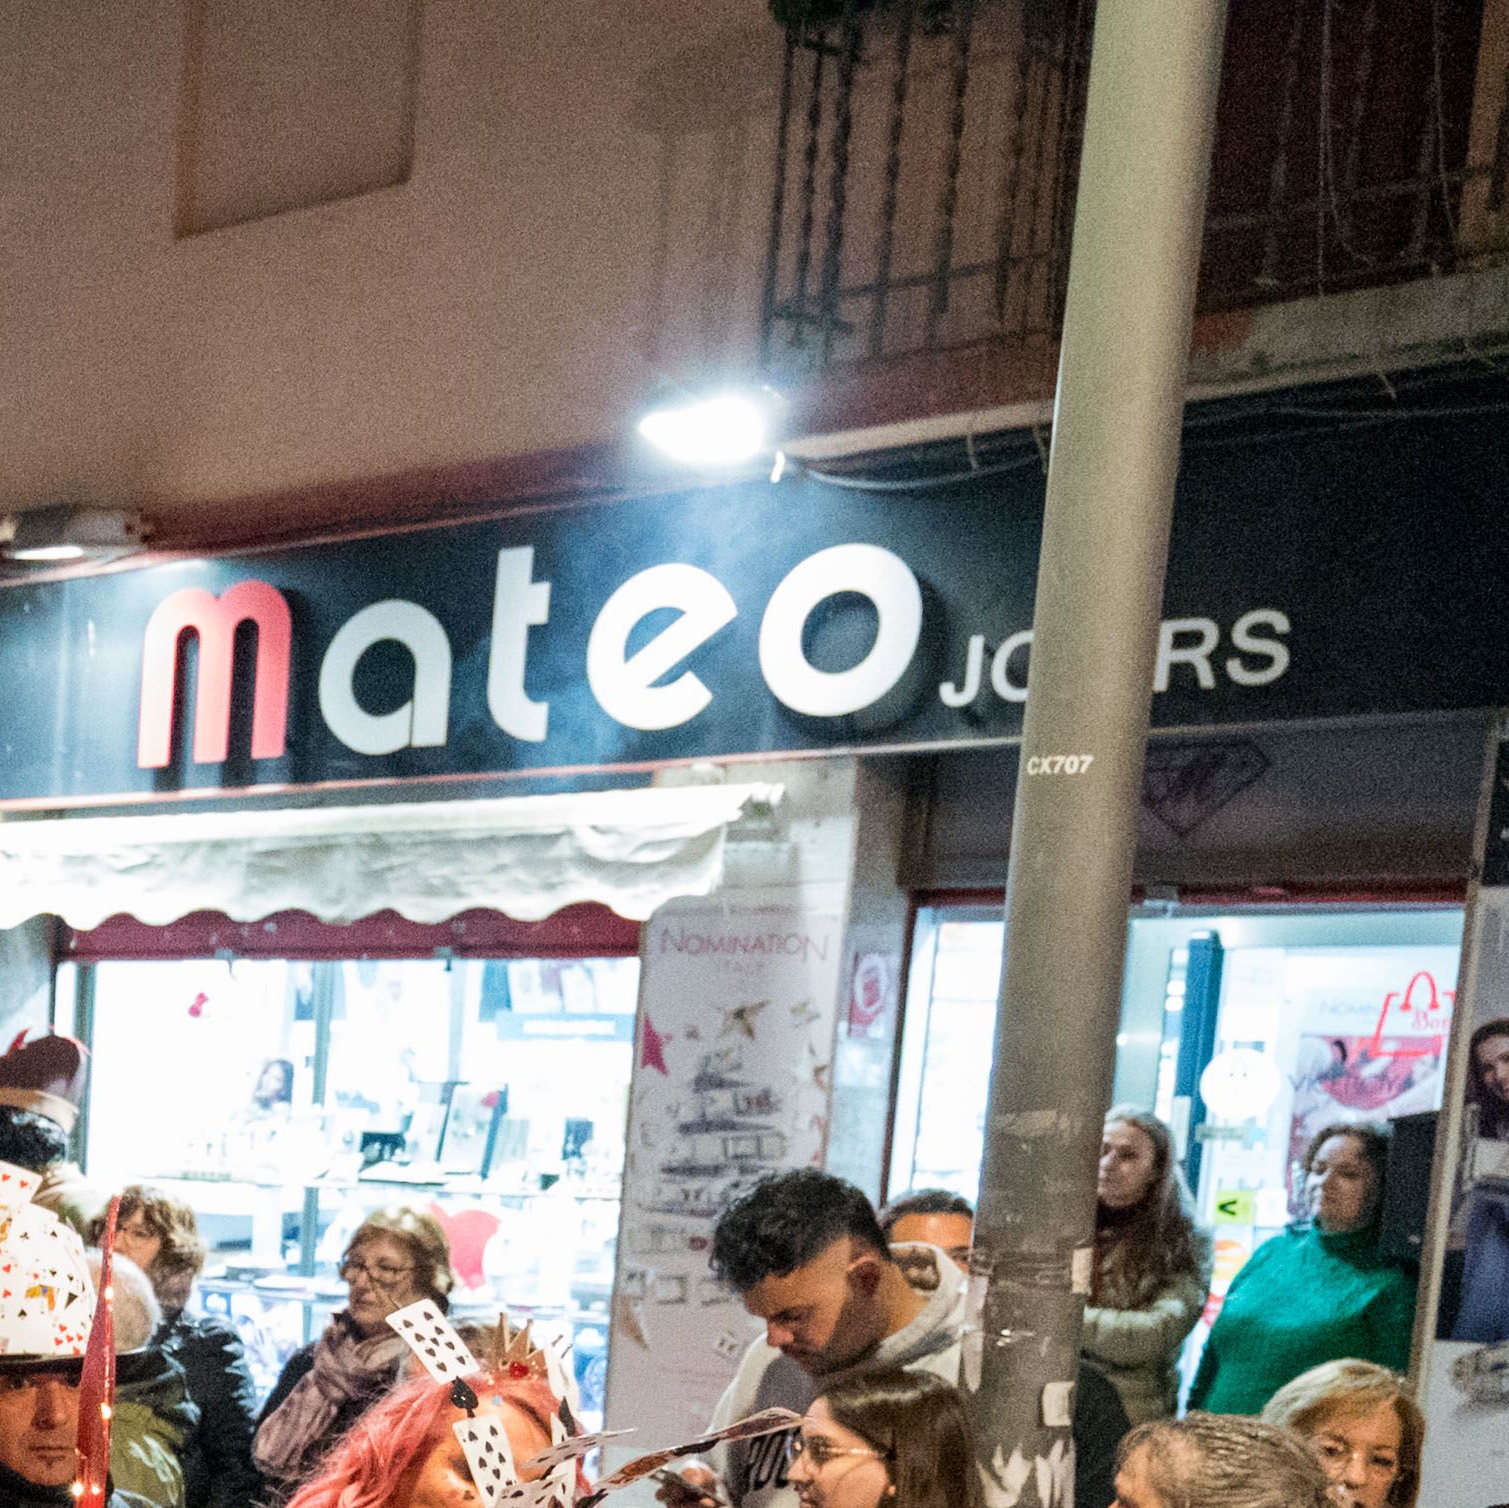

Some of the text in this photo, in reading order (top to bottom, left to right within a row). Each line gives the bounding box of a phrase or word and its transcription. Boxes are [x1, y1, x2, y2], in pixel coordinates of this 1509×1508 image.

[137, 542, 1293, 769] mateo JORS
[1027, 754, 1094, 776] CX707
[661, 928, 830, 963] NOMINATION
